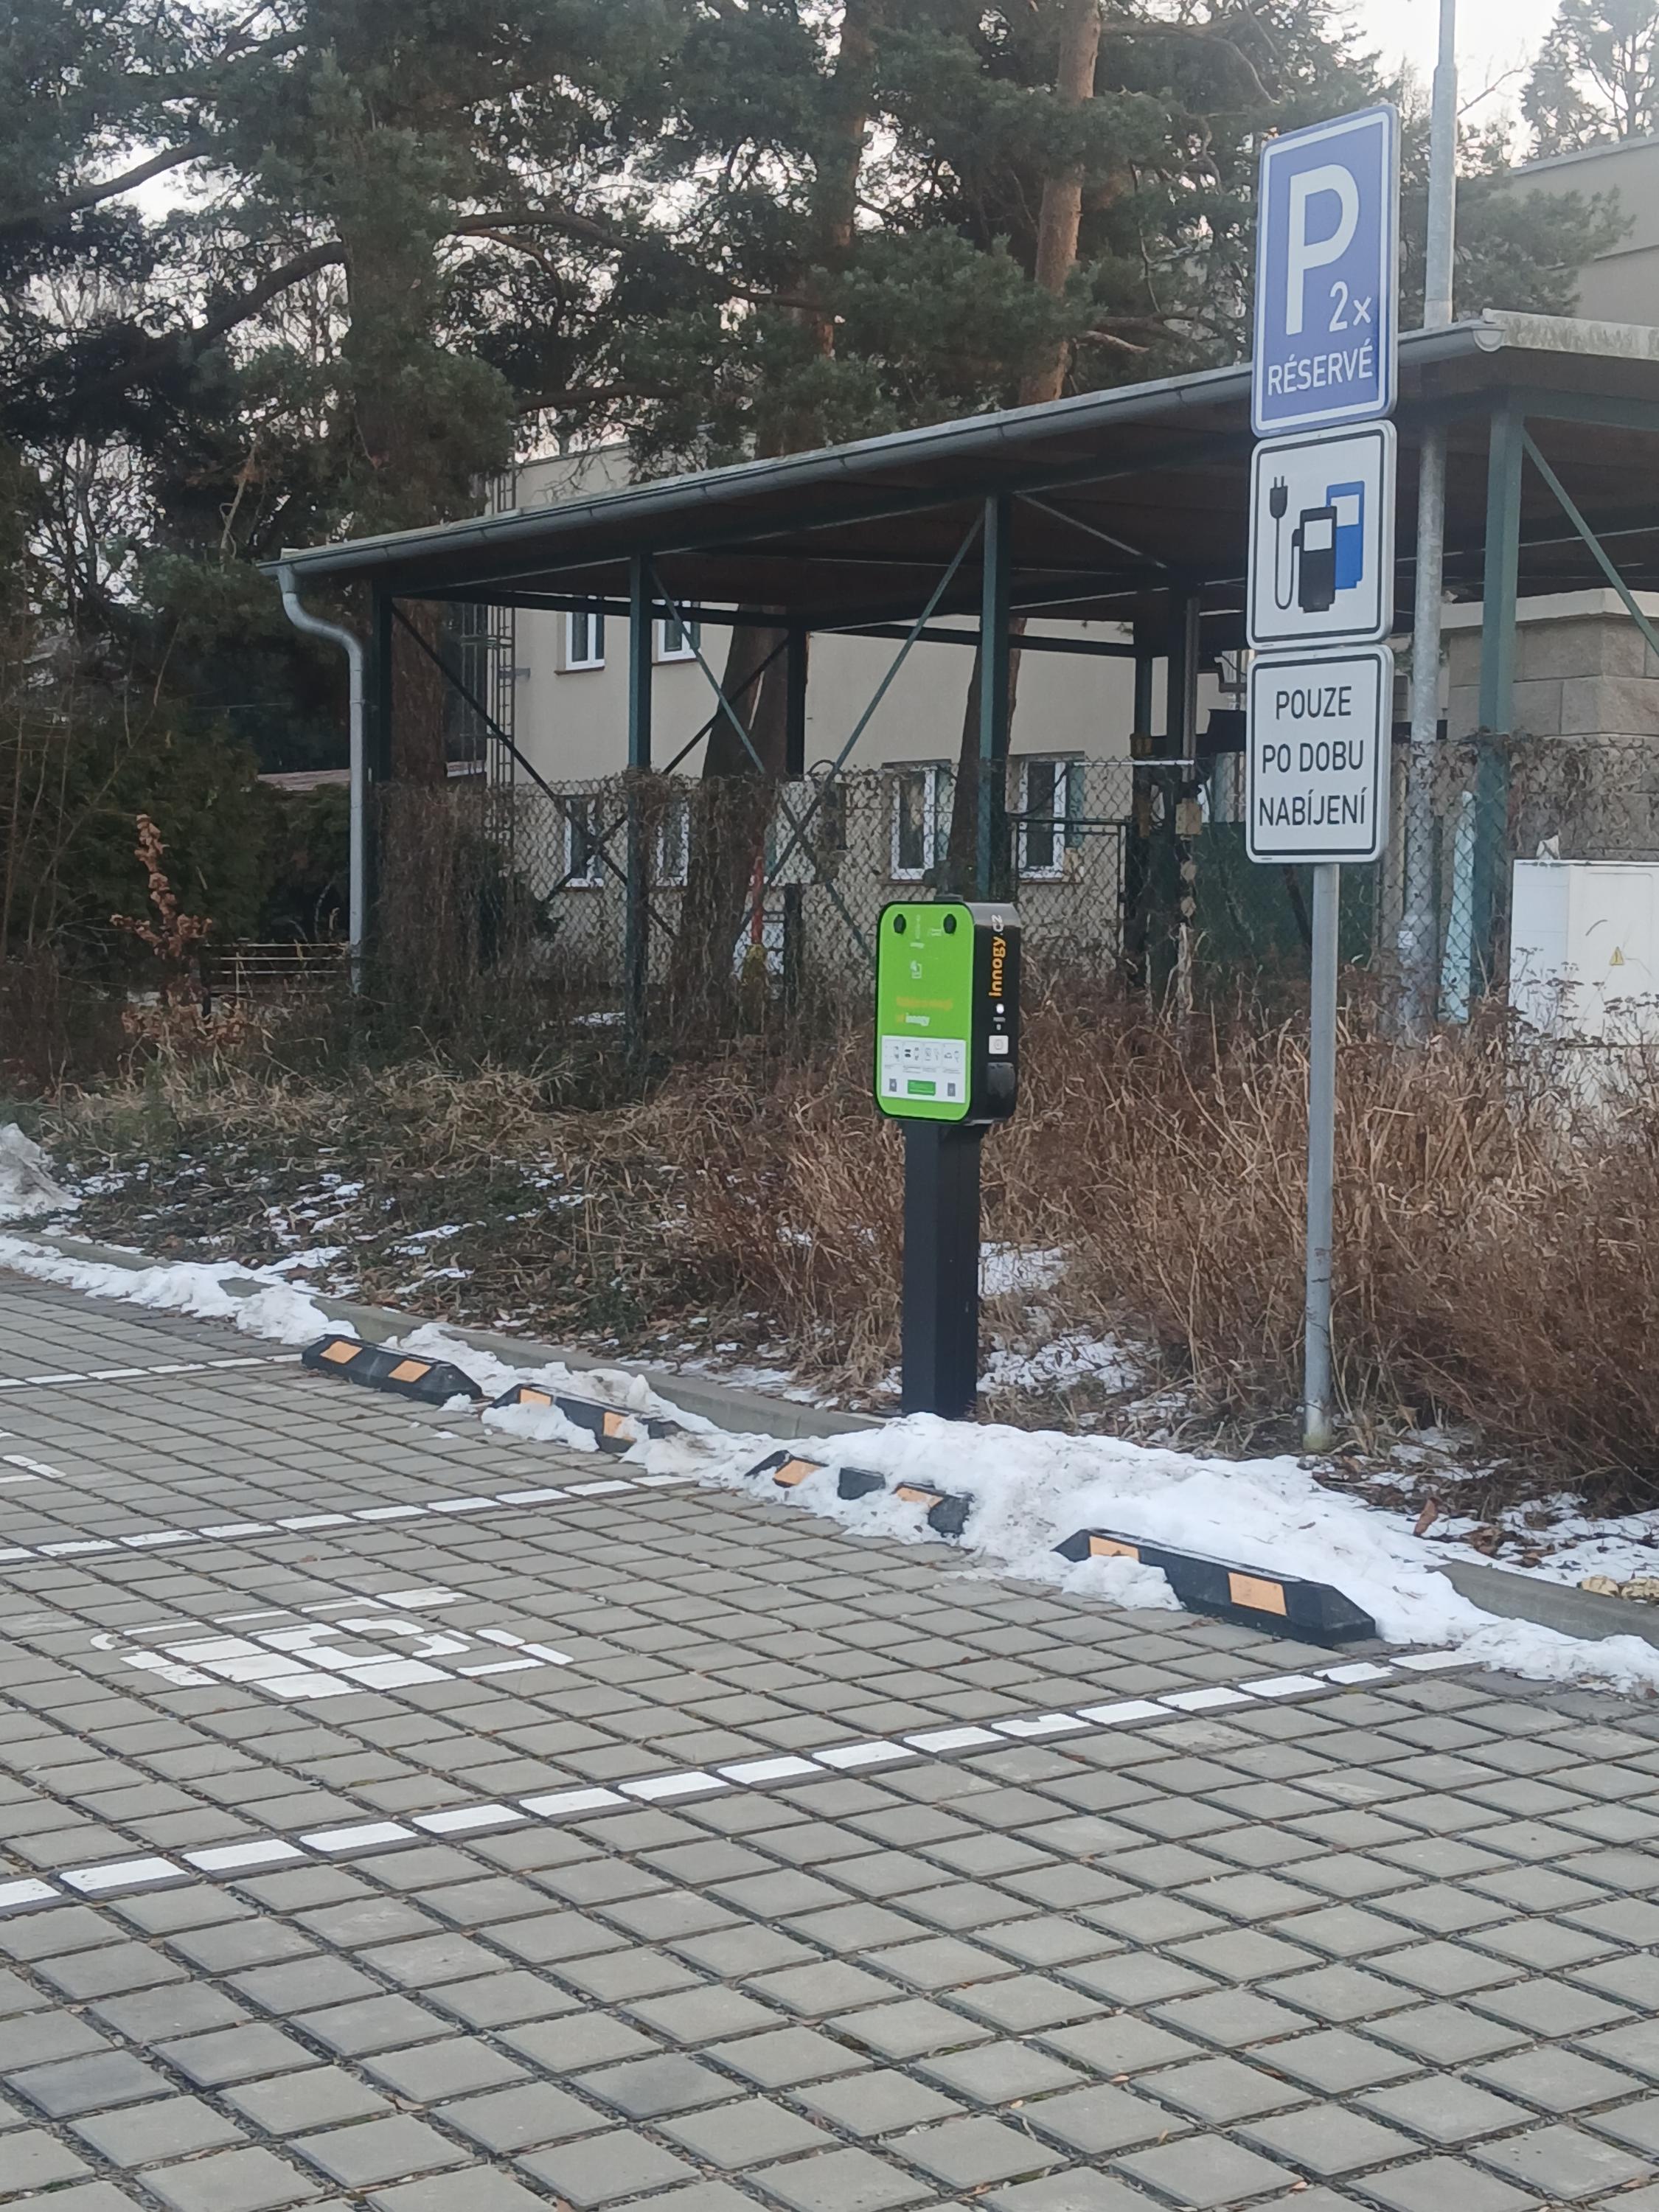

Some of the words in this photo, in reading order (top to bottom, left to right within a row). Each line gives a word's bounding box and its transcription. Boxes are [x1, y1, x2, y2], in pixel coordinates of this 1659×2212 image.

[1286, 164, 1359, 335] P
[1329, 281, 1371, 332] 2x
[1267, 338, 1373, 396] RÉSERVÉ
[1276, 686, 1352, 720] POUZE
[1262, 743, 1291, 773] PO
[1299, 740, 1363, 772] DOBU
[1259, 787, 1368, 826] NABÍJENÍ
